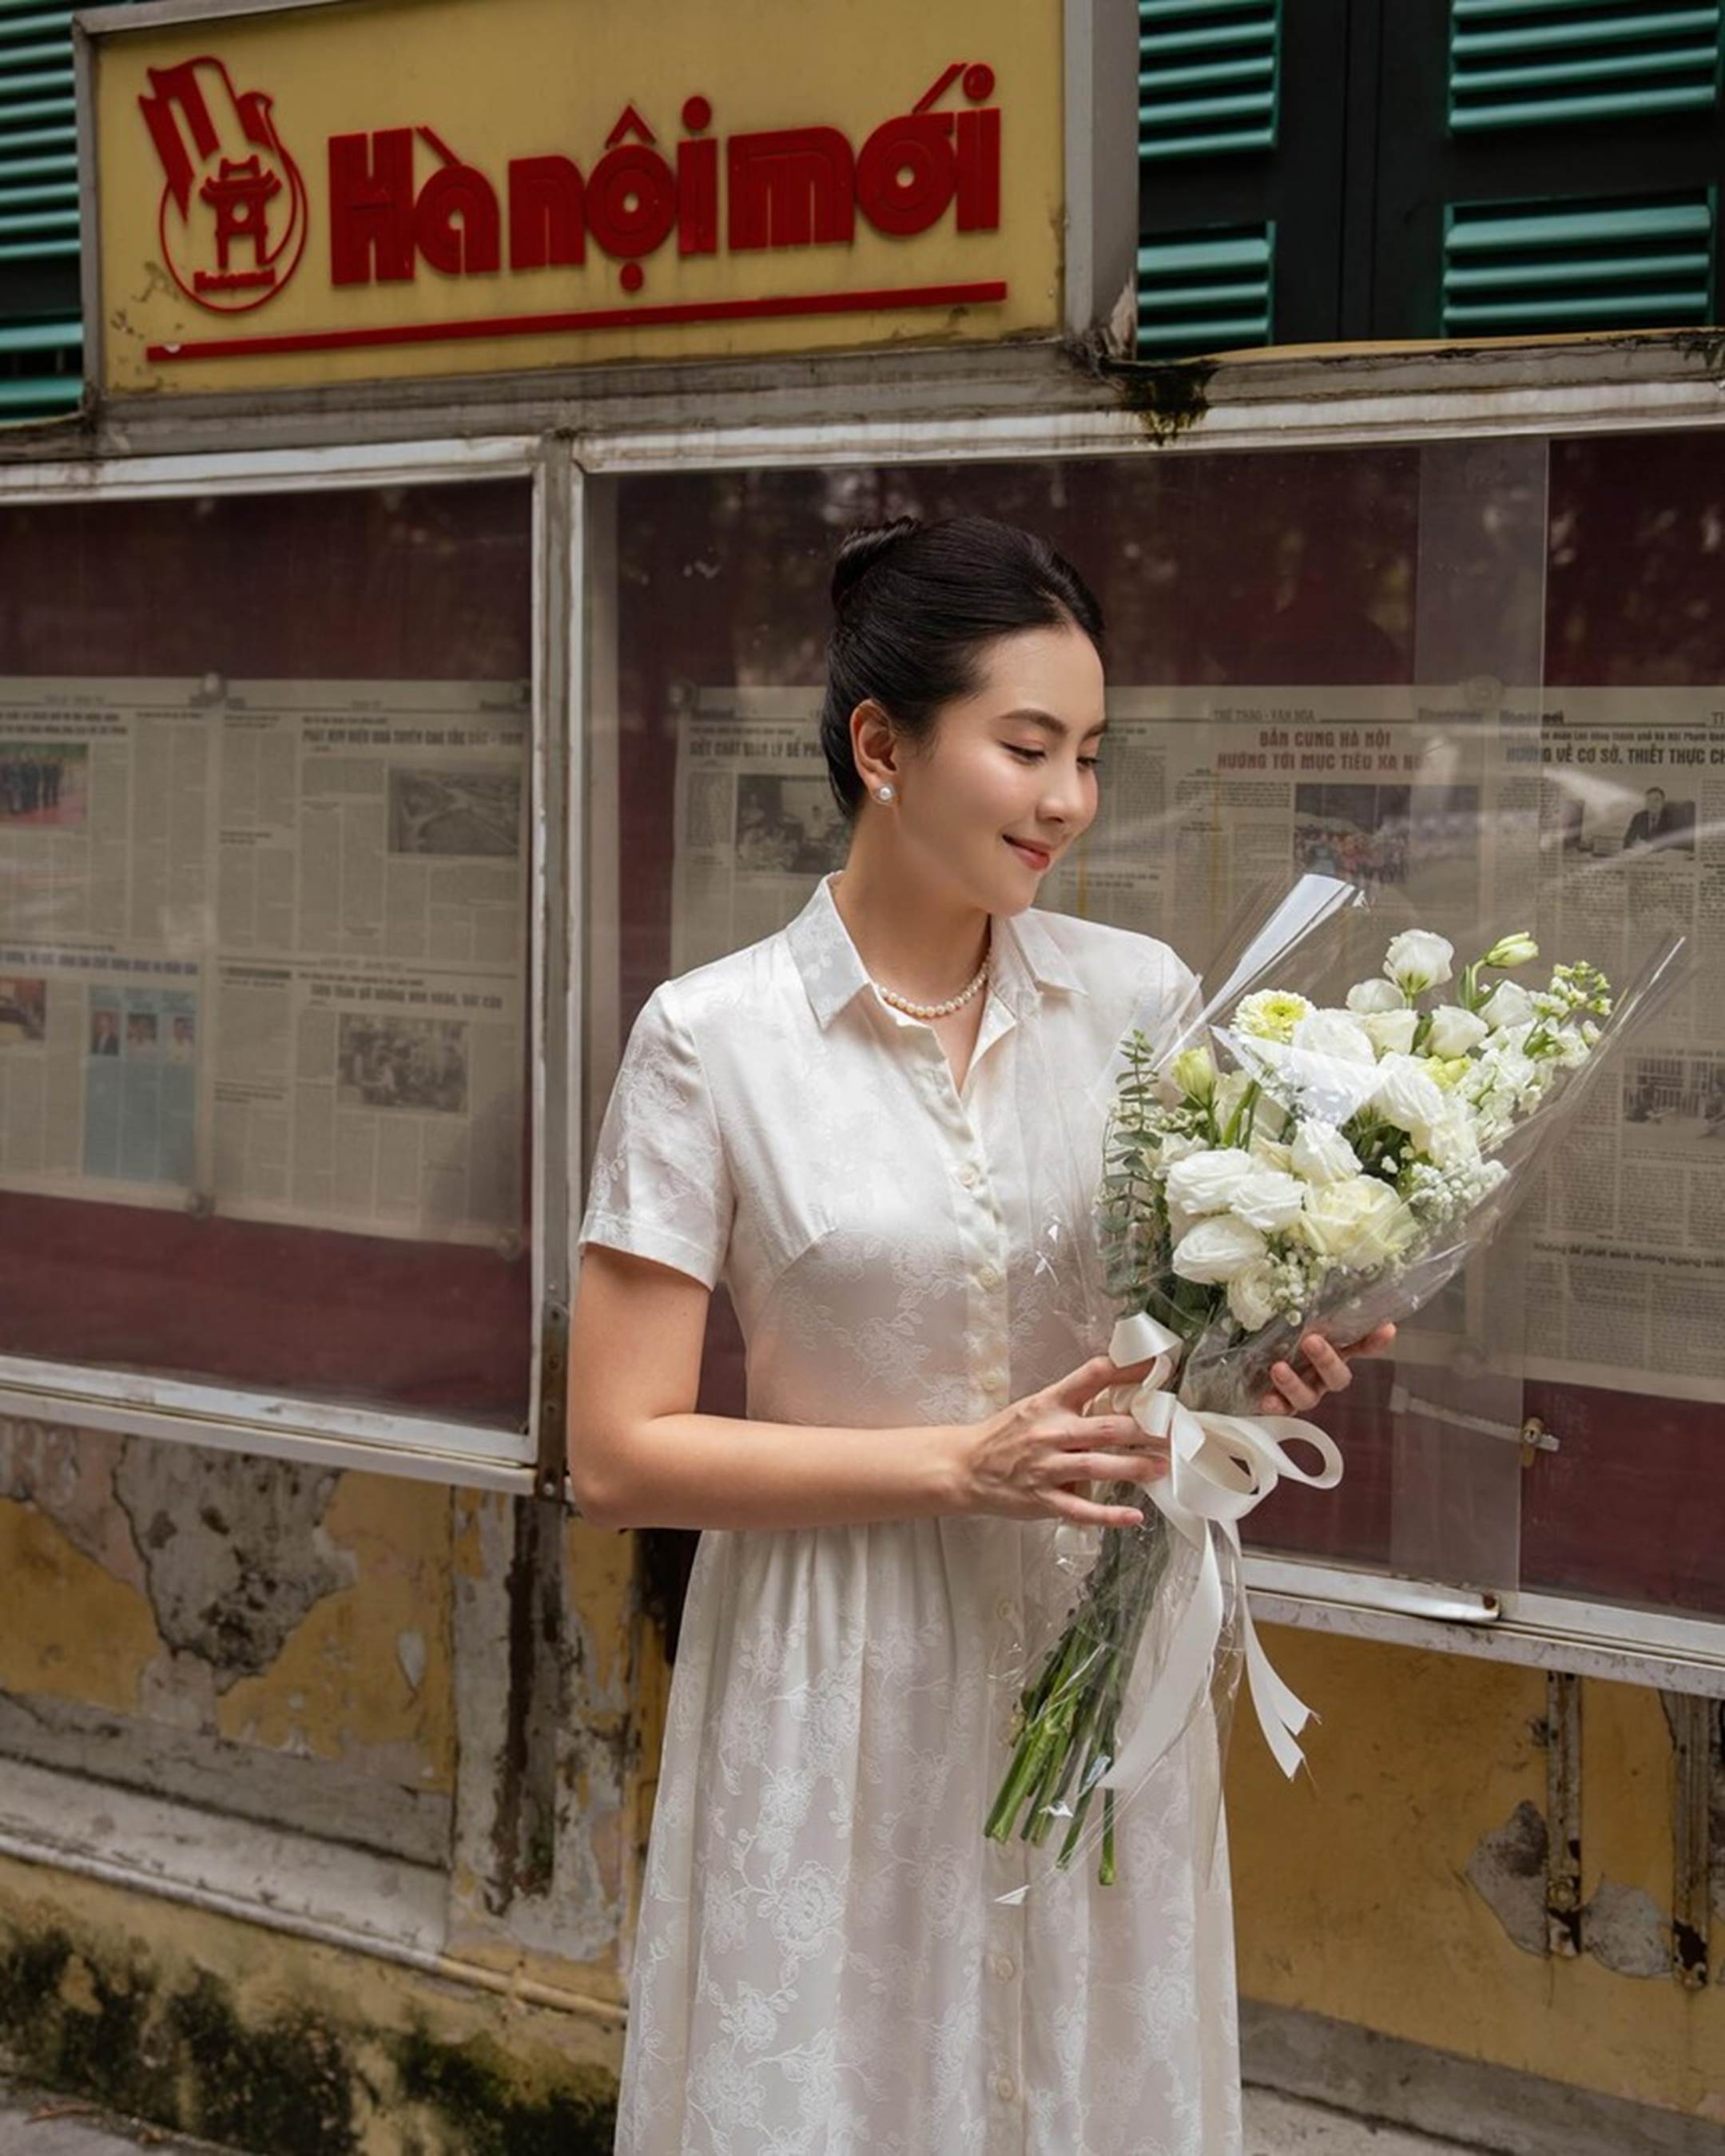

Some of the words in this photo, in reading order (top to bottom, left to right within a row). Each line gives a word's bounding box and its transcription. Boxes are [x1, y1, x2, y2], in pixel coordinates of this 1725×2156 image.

[1259, 727, 1289, 748] BẮN
[1294, 731, 1334, 748] CUNG
[1339, 728, 1360, 748] HÀ
[1365, 727, 1391, 750] NỘI
[1218, 751, 1266, 771] HƯỚNG
[1272, 752, 1294, 771] TỚI
[1301, 754, 1335, 774] MỤC
[1669, 748, 1707, 768] THỰC
